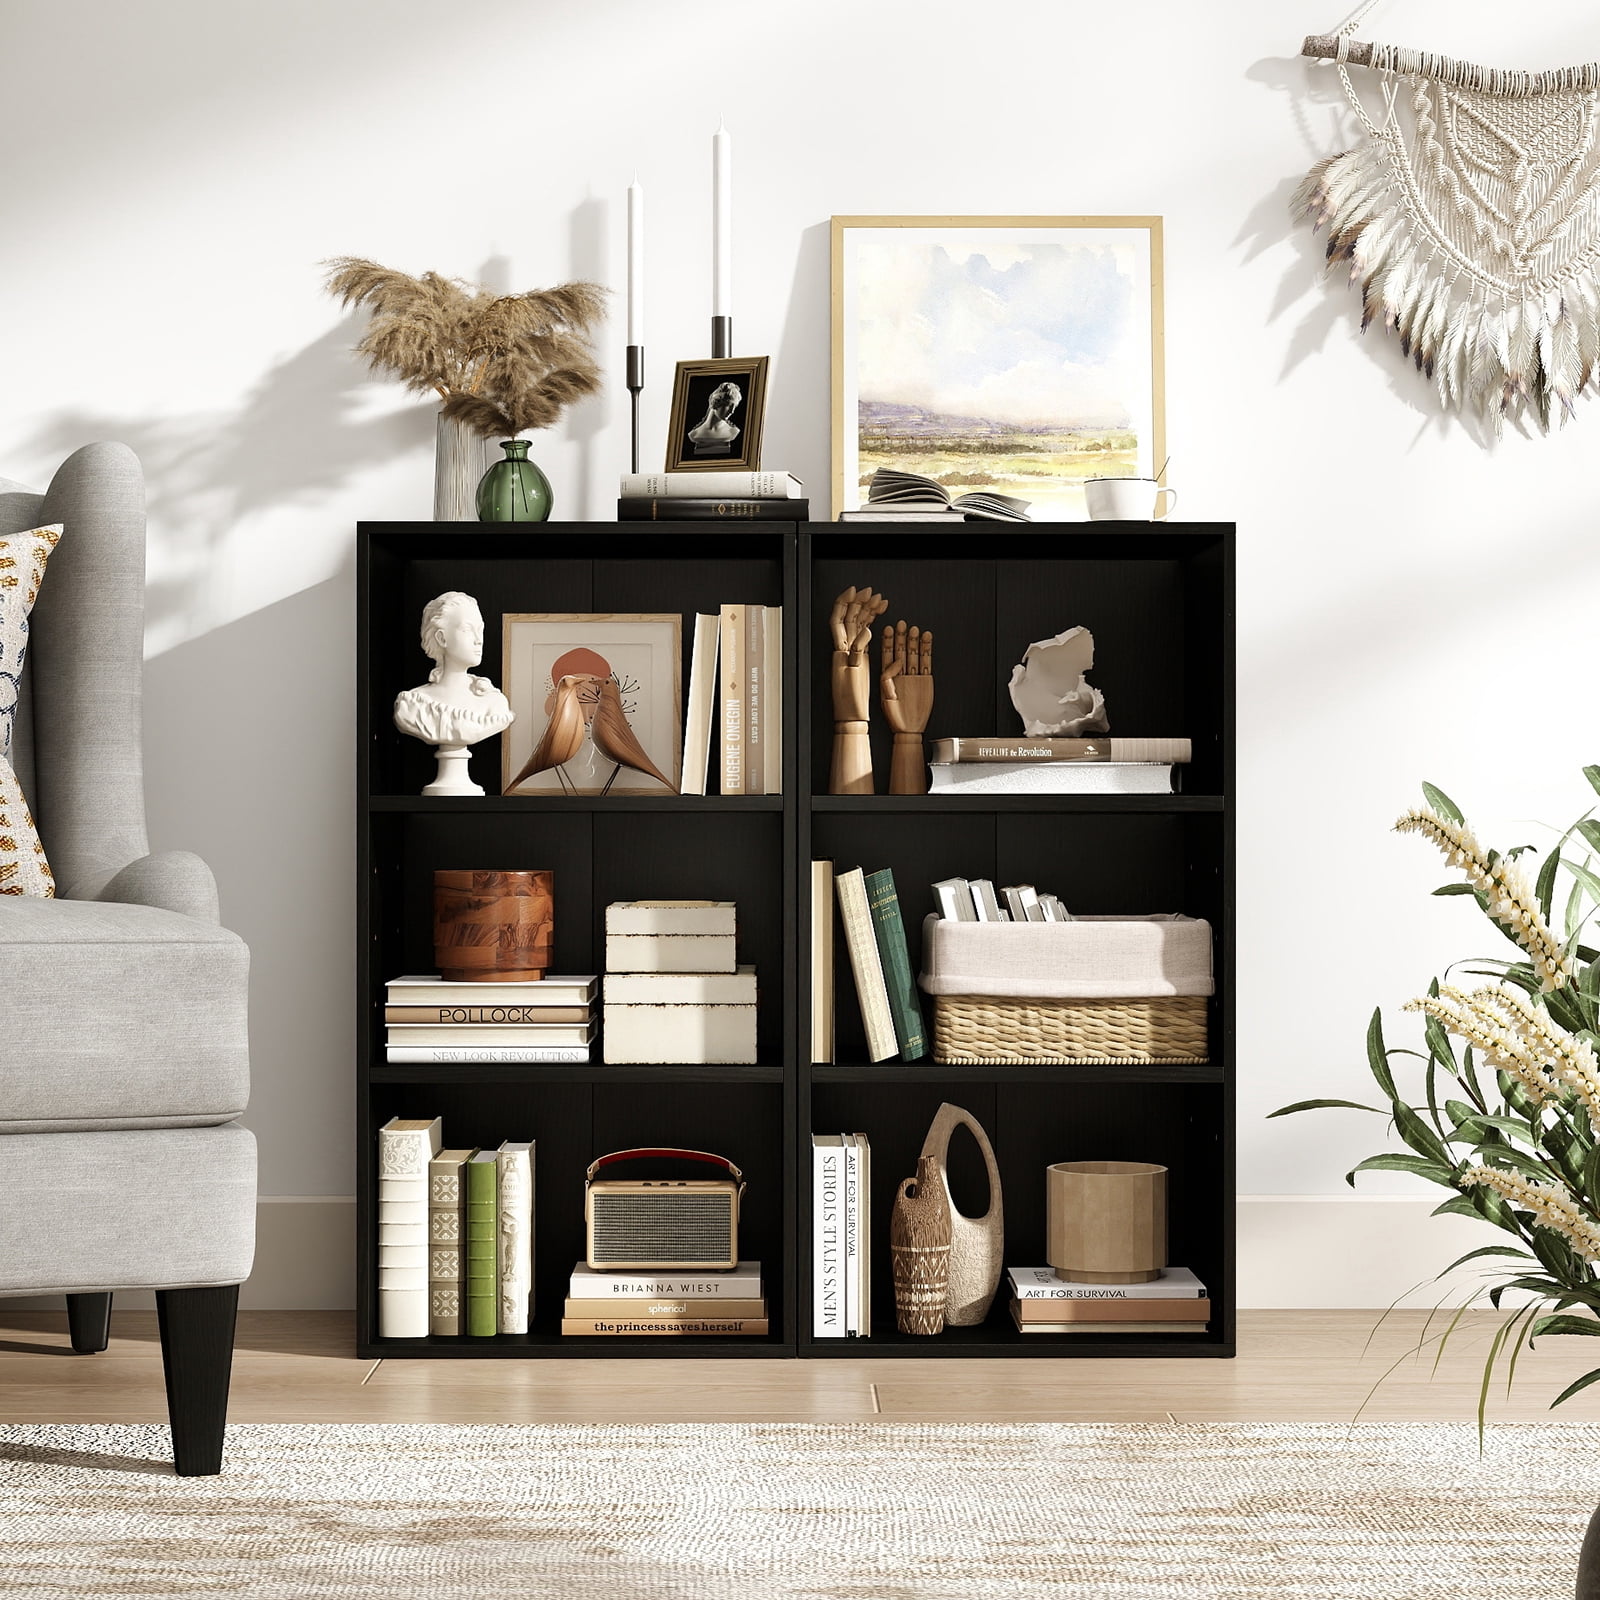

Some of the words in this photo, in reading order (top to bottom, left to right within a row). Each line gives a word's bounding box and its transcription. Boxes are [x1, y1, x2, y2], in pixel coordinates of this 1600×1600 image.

[751, 684, 758, 694] DO
[751, 695, 758, 706] WE
[726, 699, 740, 741] ONEGIN
[1018, 746, 1052, 757] Revolution
[726, 744, 740, 788] EUGENE
[439, 1008, 533, 1023] POLLOCK
[433, 1051, 460, 1061] NEW
[464, 1051, 497, 1061] LOOK
[501, 1051, 579, 1061] REVOLUTION
[848, 1155, 856, 1176] ART
[823, 1155, 836, 1221] STORIES
[848, 1180, 856, 1203] FOR
[848, 1207, 856, 1257] SURVIVAL
[823, 1225, 836, 1274] STYLE
[613, 1284, 674, 1292] BRIANNA
[680, 1284, 720, 1292] WIEST
[1025, 1290, 1046, 1298] ART
[1050, 1290, 1073, 1298] FOR
[1076, 1290, 1127, 1298] SURVIVAL
[648, 1303, 687, 1315] spherical
[823, 1278, 836, 1325] MEN'S
[594, 1322, 614, 1331] the
[616, 1321, 666, 1333] princess
[701, 1321, 743, 1331] herself
